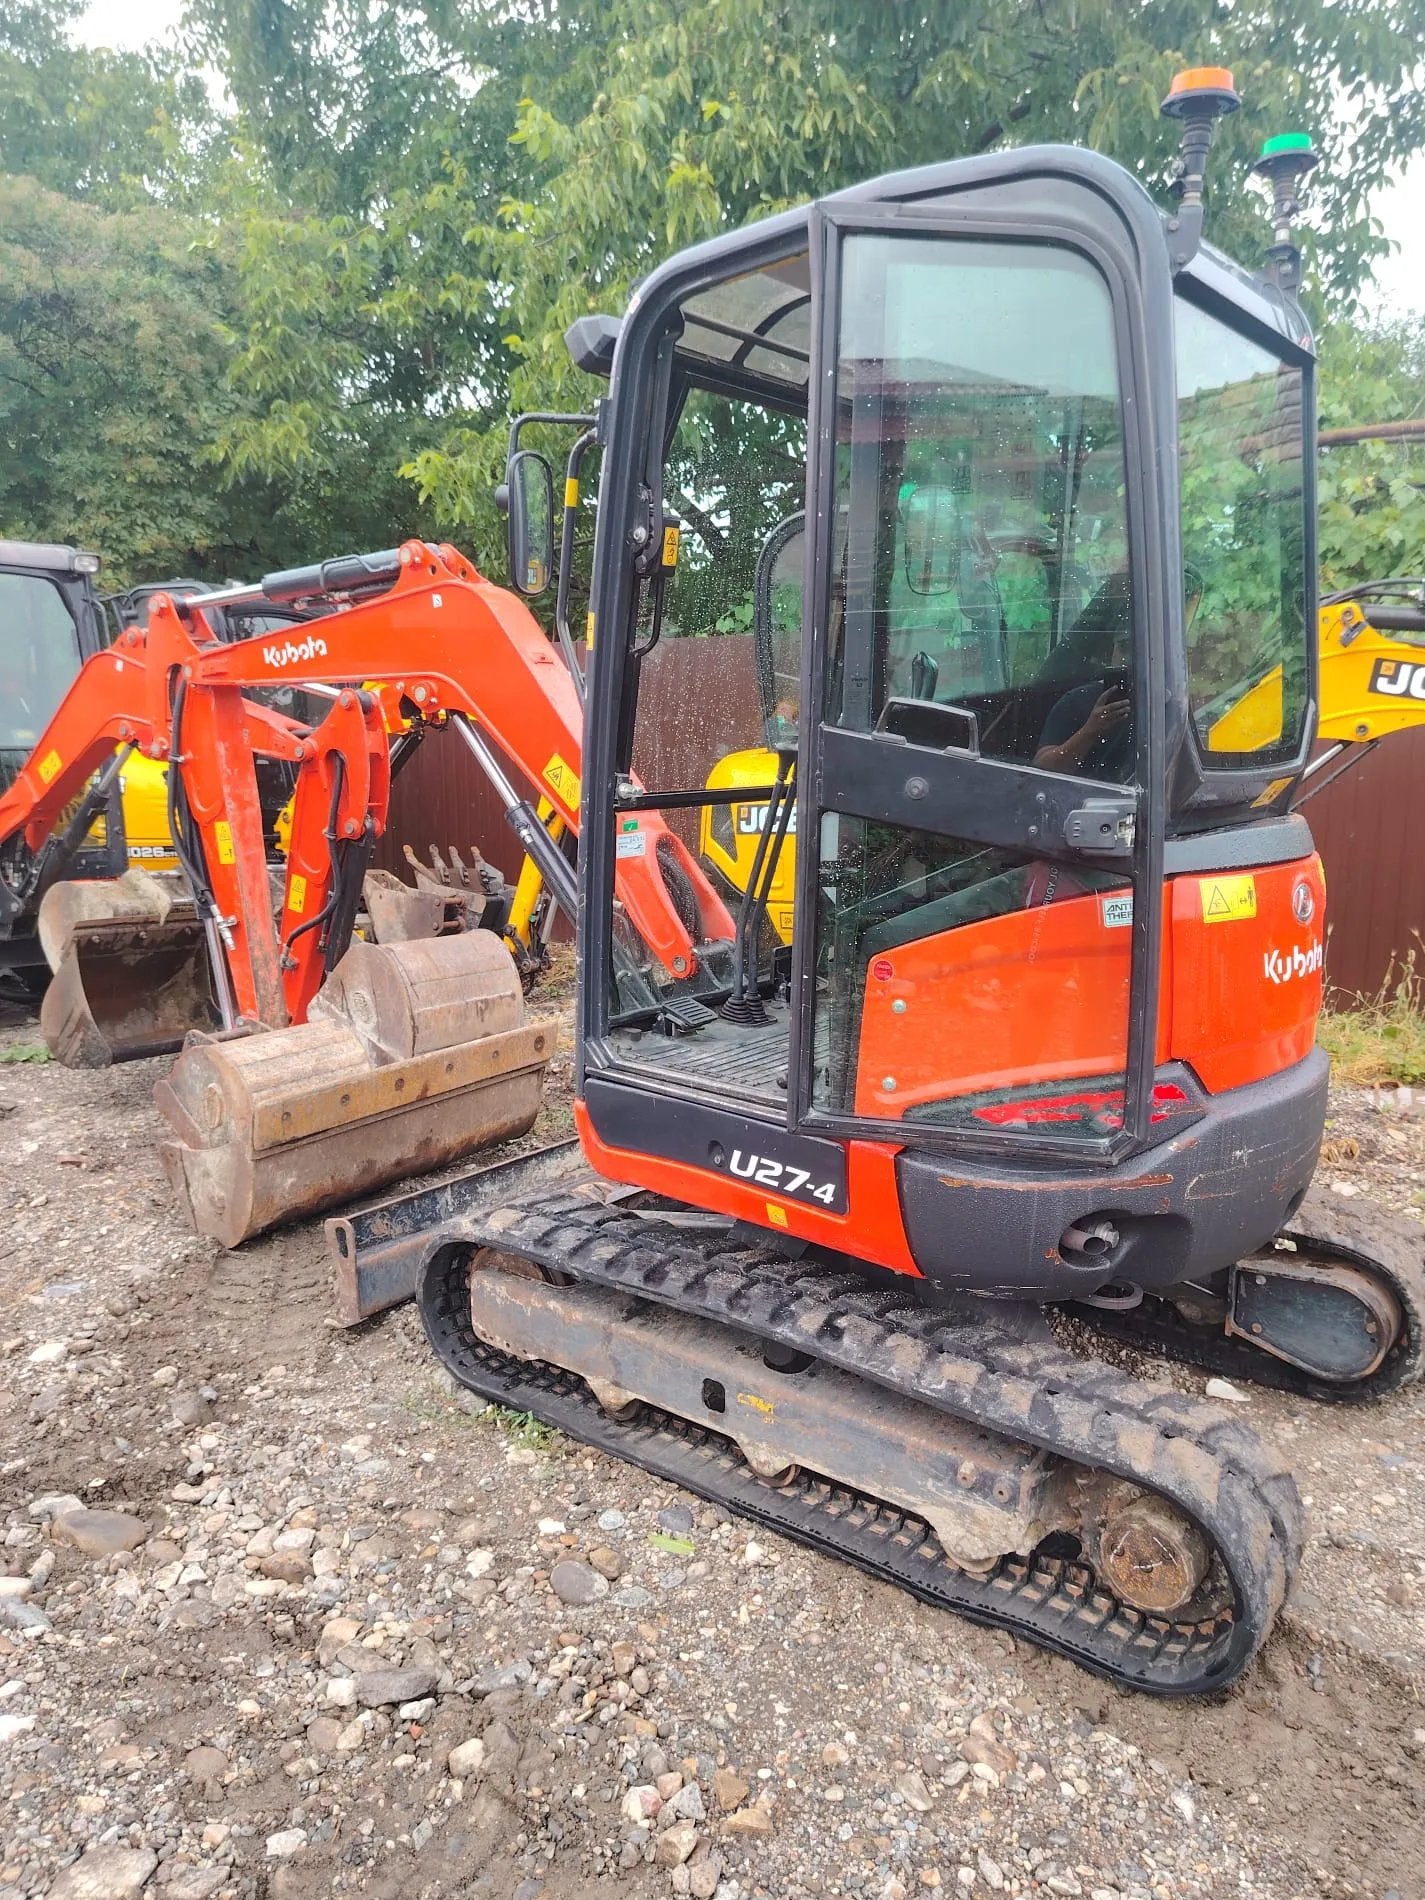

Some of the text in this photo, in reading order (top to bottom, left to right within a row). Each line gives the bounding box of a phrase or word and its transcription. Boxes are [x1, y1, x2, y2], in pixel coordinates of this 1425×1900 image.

[263, 636, 328, 668] Kubota
[127, 846, 164, 858] 026
[1107, 903, 1132, 912] ANTI
[1264, 938, 1322, 984] Kubota
[730, 1150, 836, 1204] U27-4
